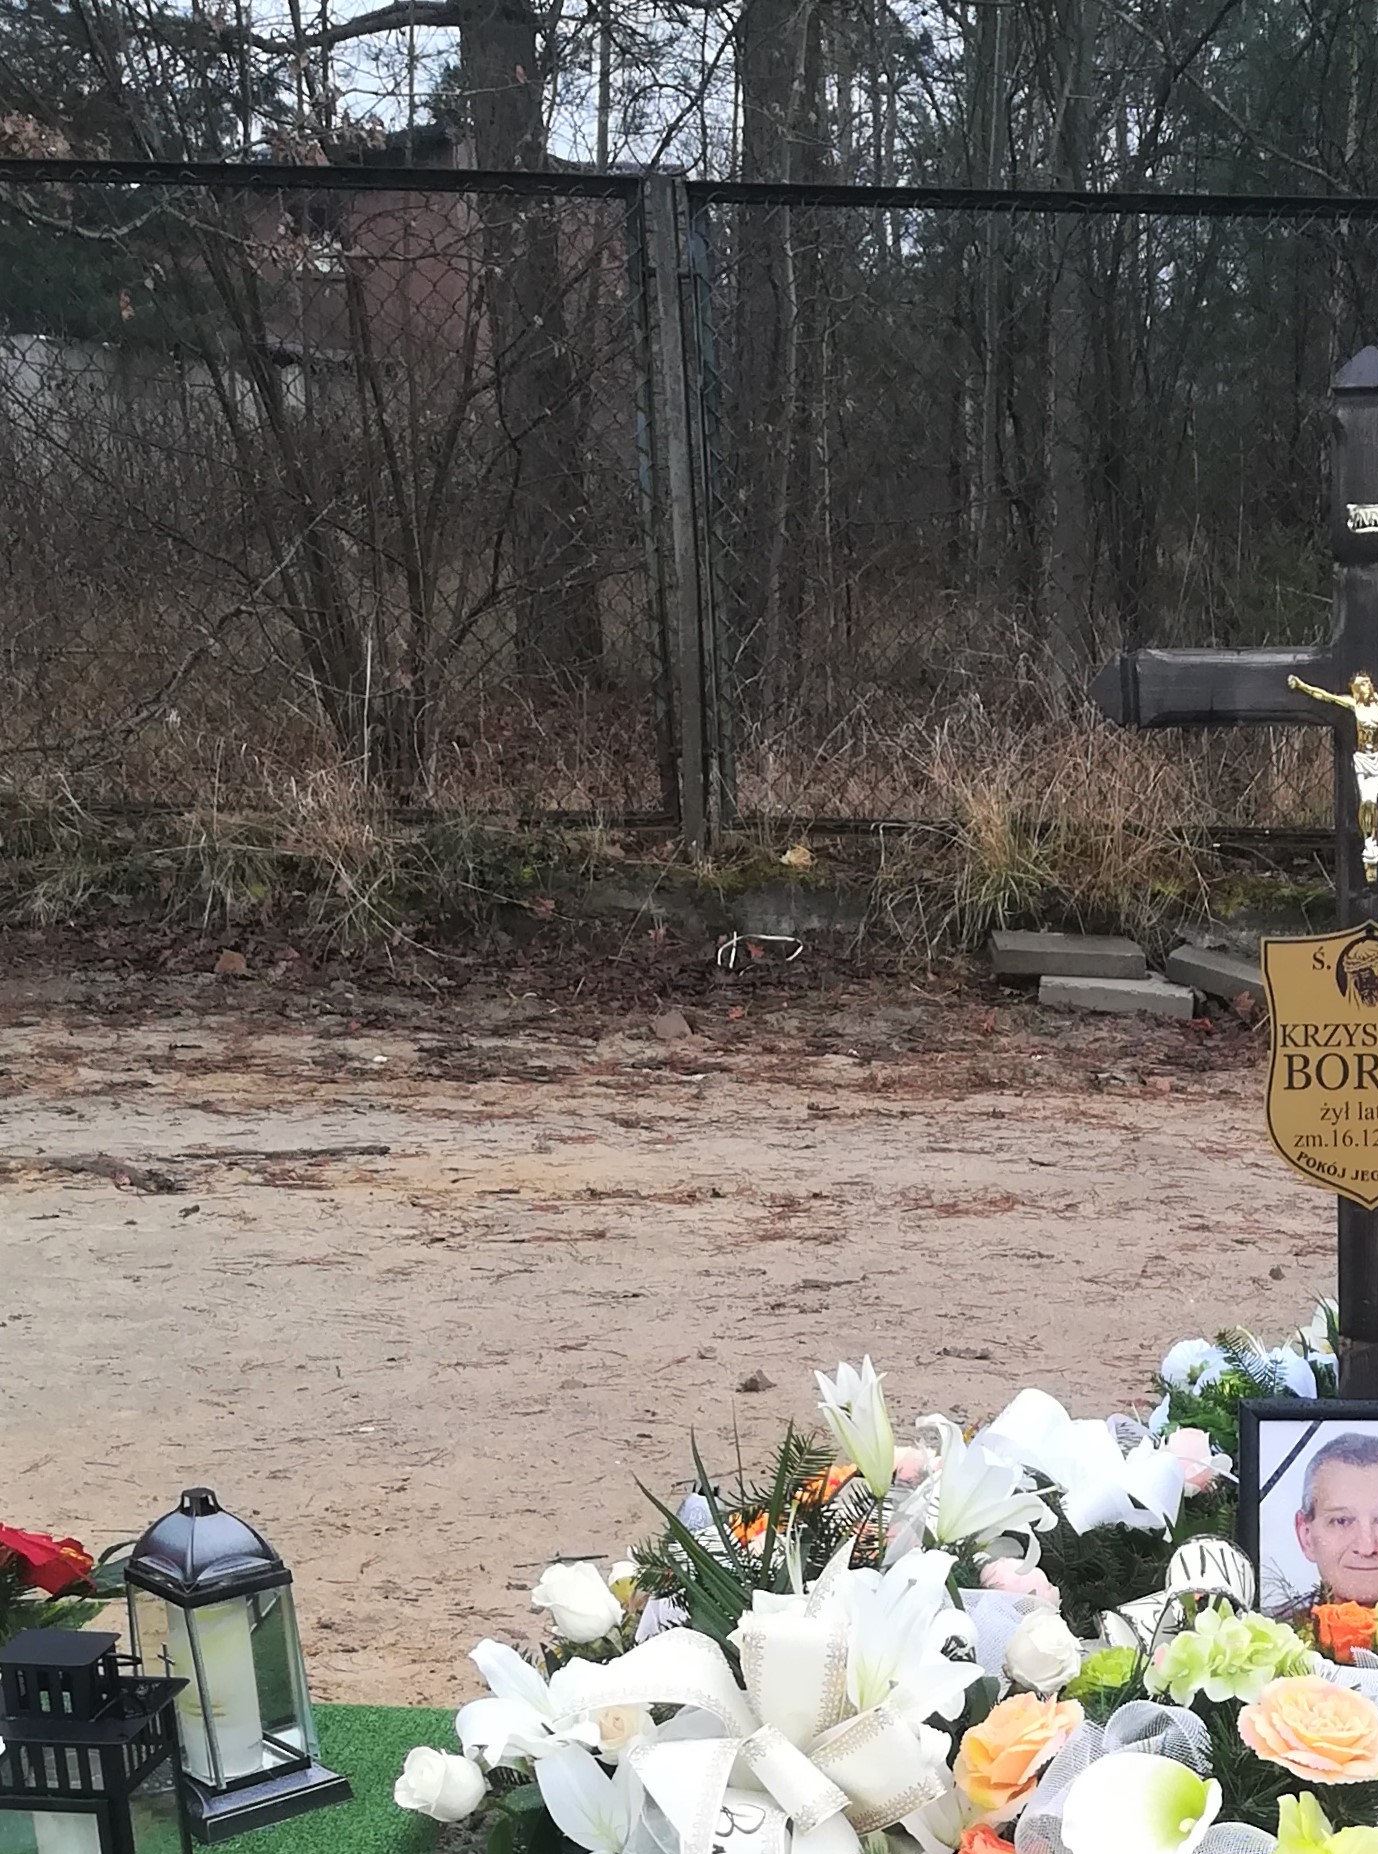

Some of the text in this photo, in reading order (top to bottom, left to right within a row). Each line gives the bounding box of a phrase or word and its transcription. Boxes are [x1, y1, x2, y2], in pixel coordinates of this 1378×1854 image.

[1312, 946, 1331, 970] Ś.
[1320, 1102, 1351, 1125] żył
[1296, 1151, 1346, 1178] POKÓJ
